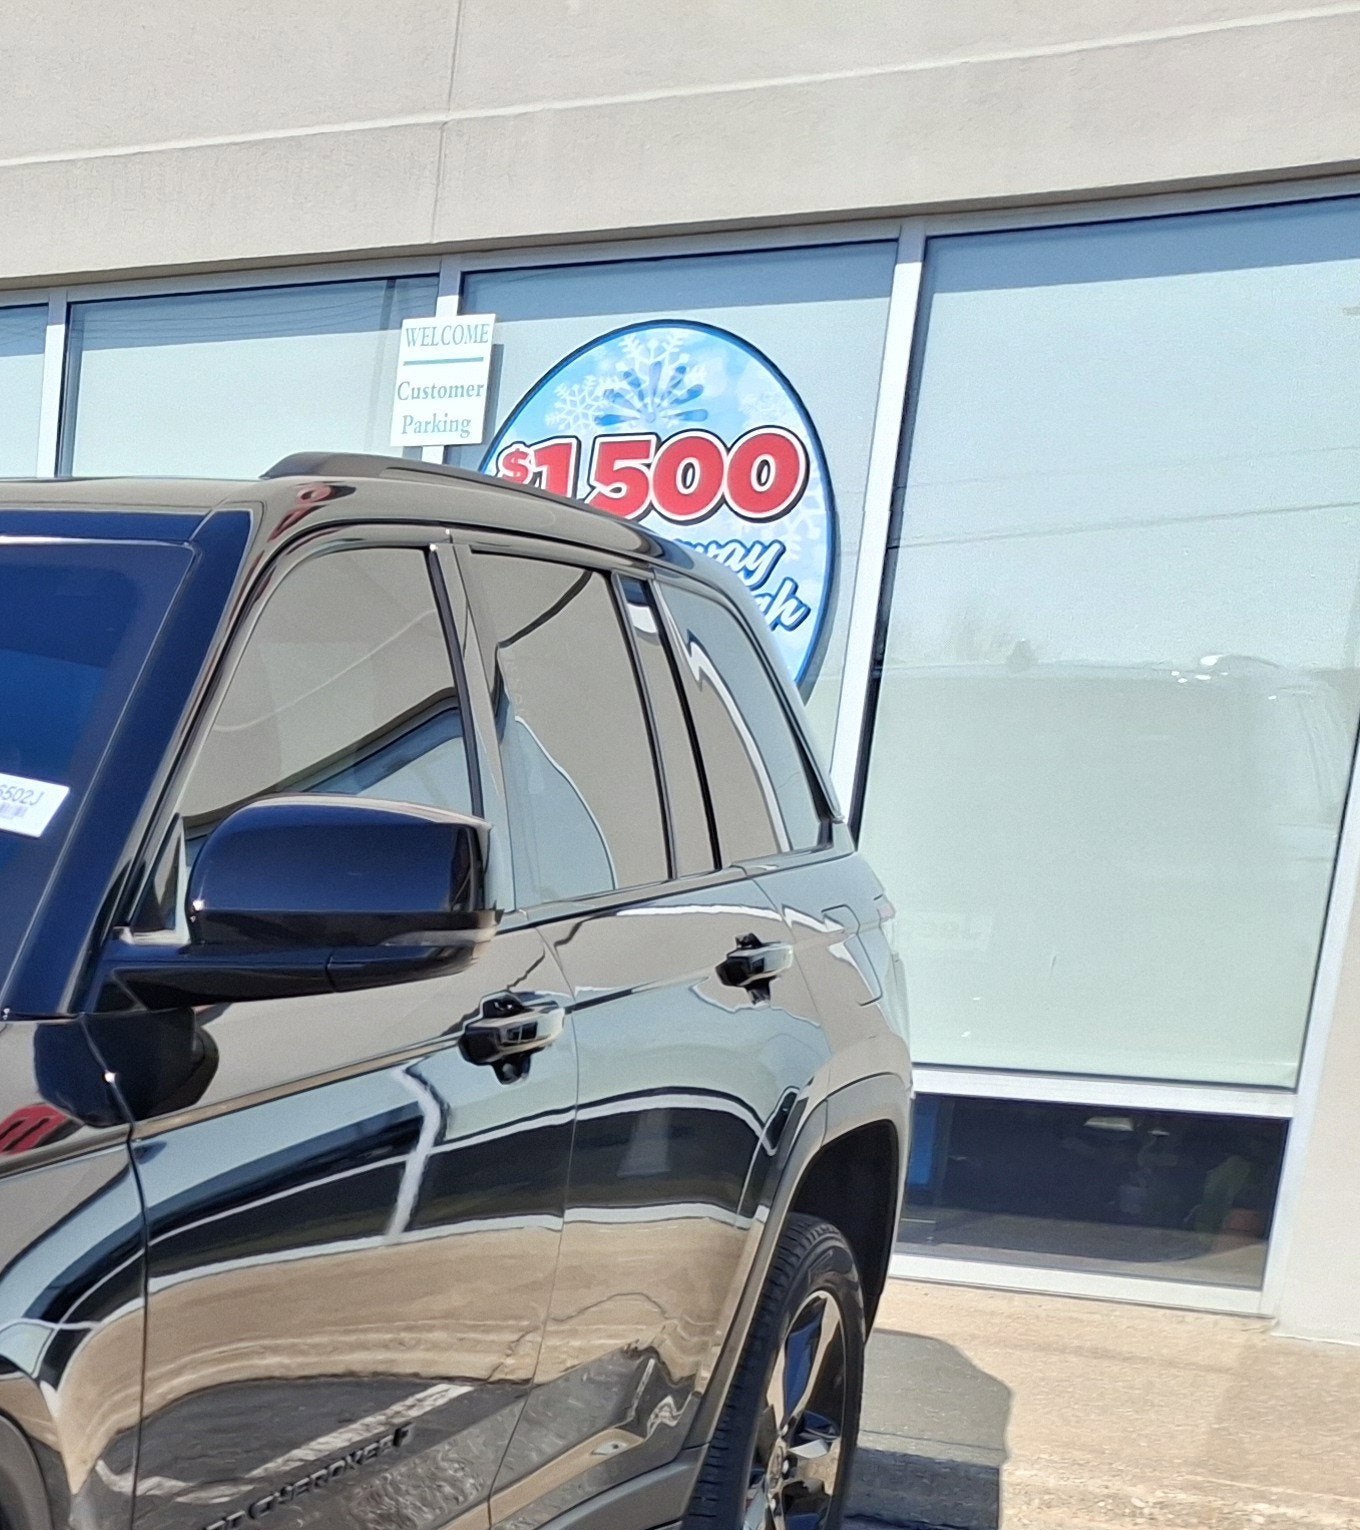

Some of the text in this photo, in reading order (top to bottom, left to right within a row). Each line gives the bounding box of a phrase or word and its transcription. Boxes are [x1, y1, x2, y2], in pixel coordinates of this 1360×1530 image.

[405, 323, 490, 348] WELCOME
[396, 380, 485, 401] Customer
[400, 412, 472, 439] Parking
